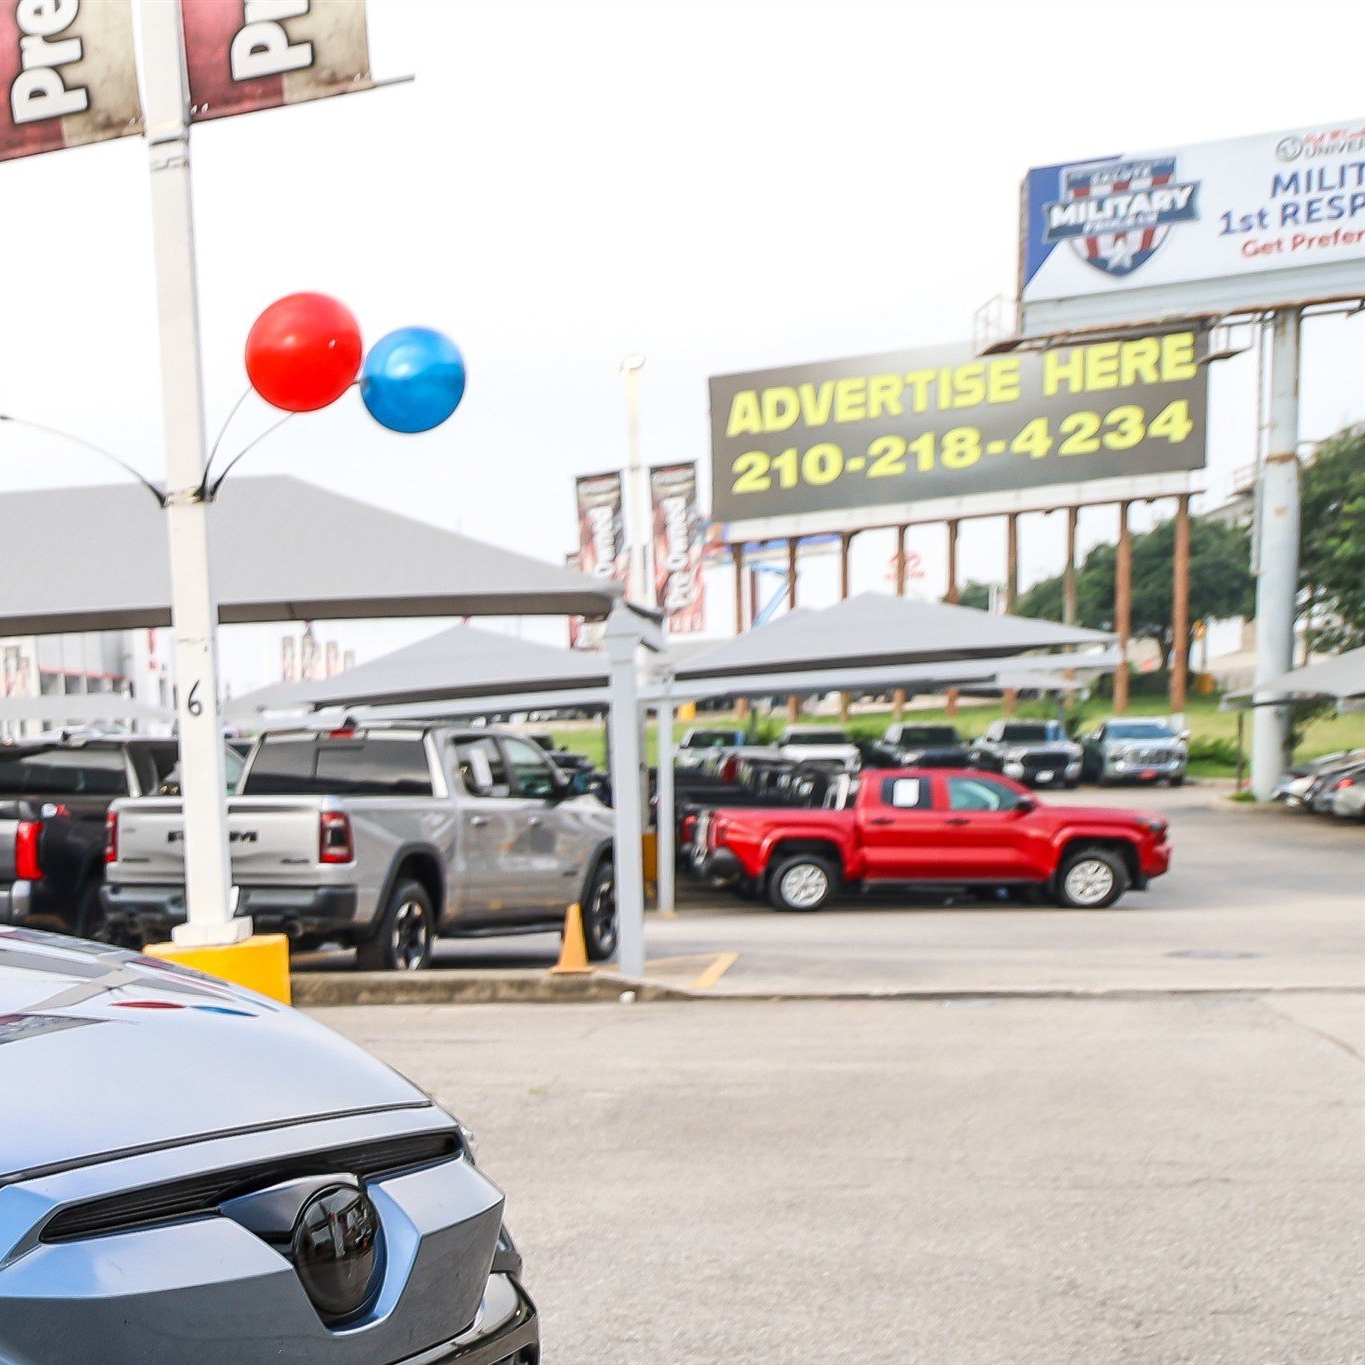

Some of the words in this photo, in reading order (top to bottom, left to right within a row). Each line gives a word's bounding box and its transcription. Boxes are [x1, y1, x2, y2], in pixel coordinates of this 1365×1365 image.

[1048, 184, 1194, 229] MILITARY
[1219, 207, 1269, 236] 1st
[1241, 237, 1283, 258] Get
[725, 357, 1021, 438] ADVERTISE
[1043, 332, 1198, 397] HERE
[730, 399, 1194, 495] 210-218-4234
[187, 679, 203, 717] 6
